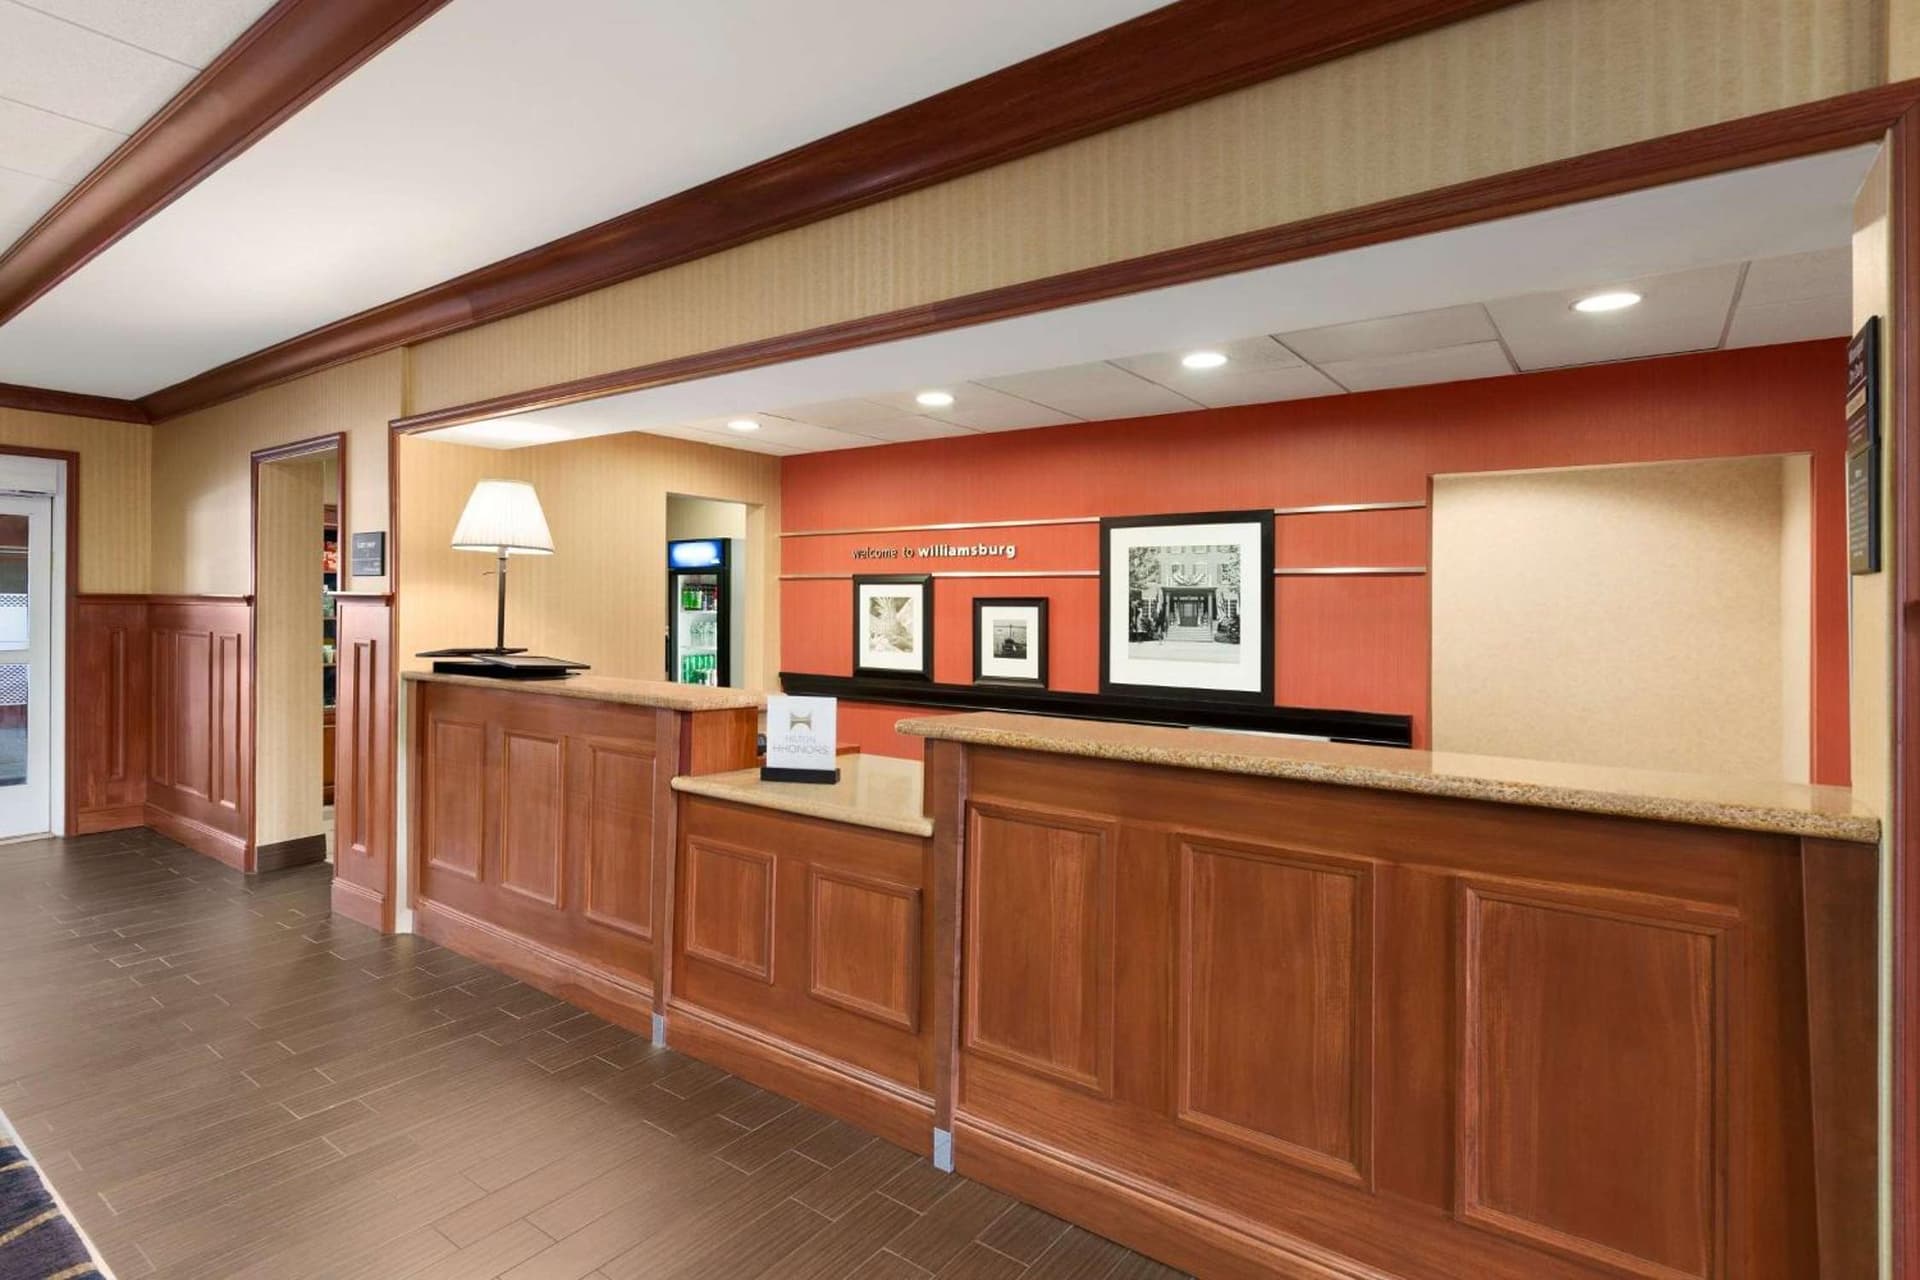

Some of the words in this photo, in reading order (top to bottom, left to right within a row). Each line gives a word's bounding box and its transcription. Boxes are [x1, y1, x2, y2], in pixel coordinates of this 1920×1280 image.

[853, 547, 898, 559] welcome
[904, 547, 915, 558] to
[918, 543, 1017, 559] williamsburg
